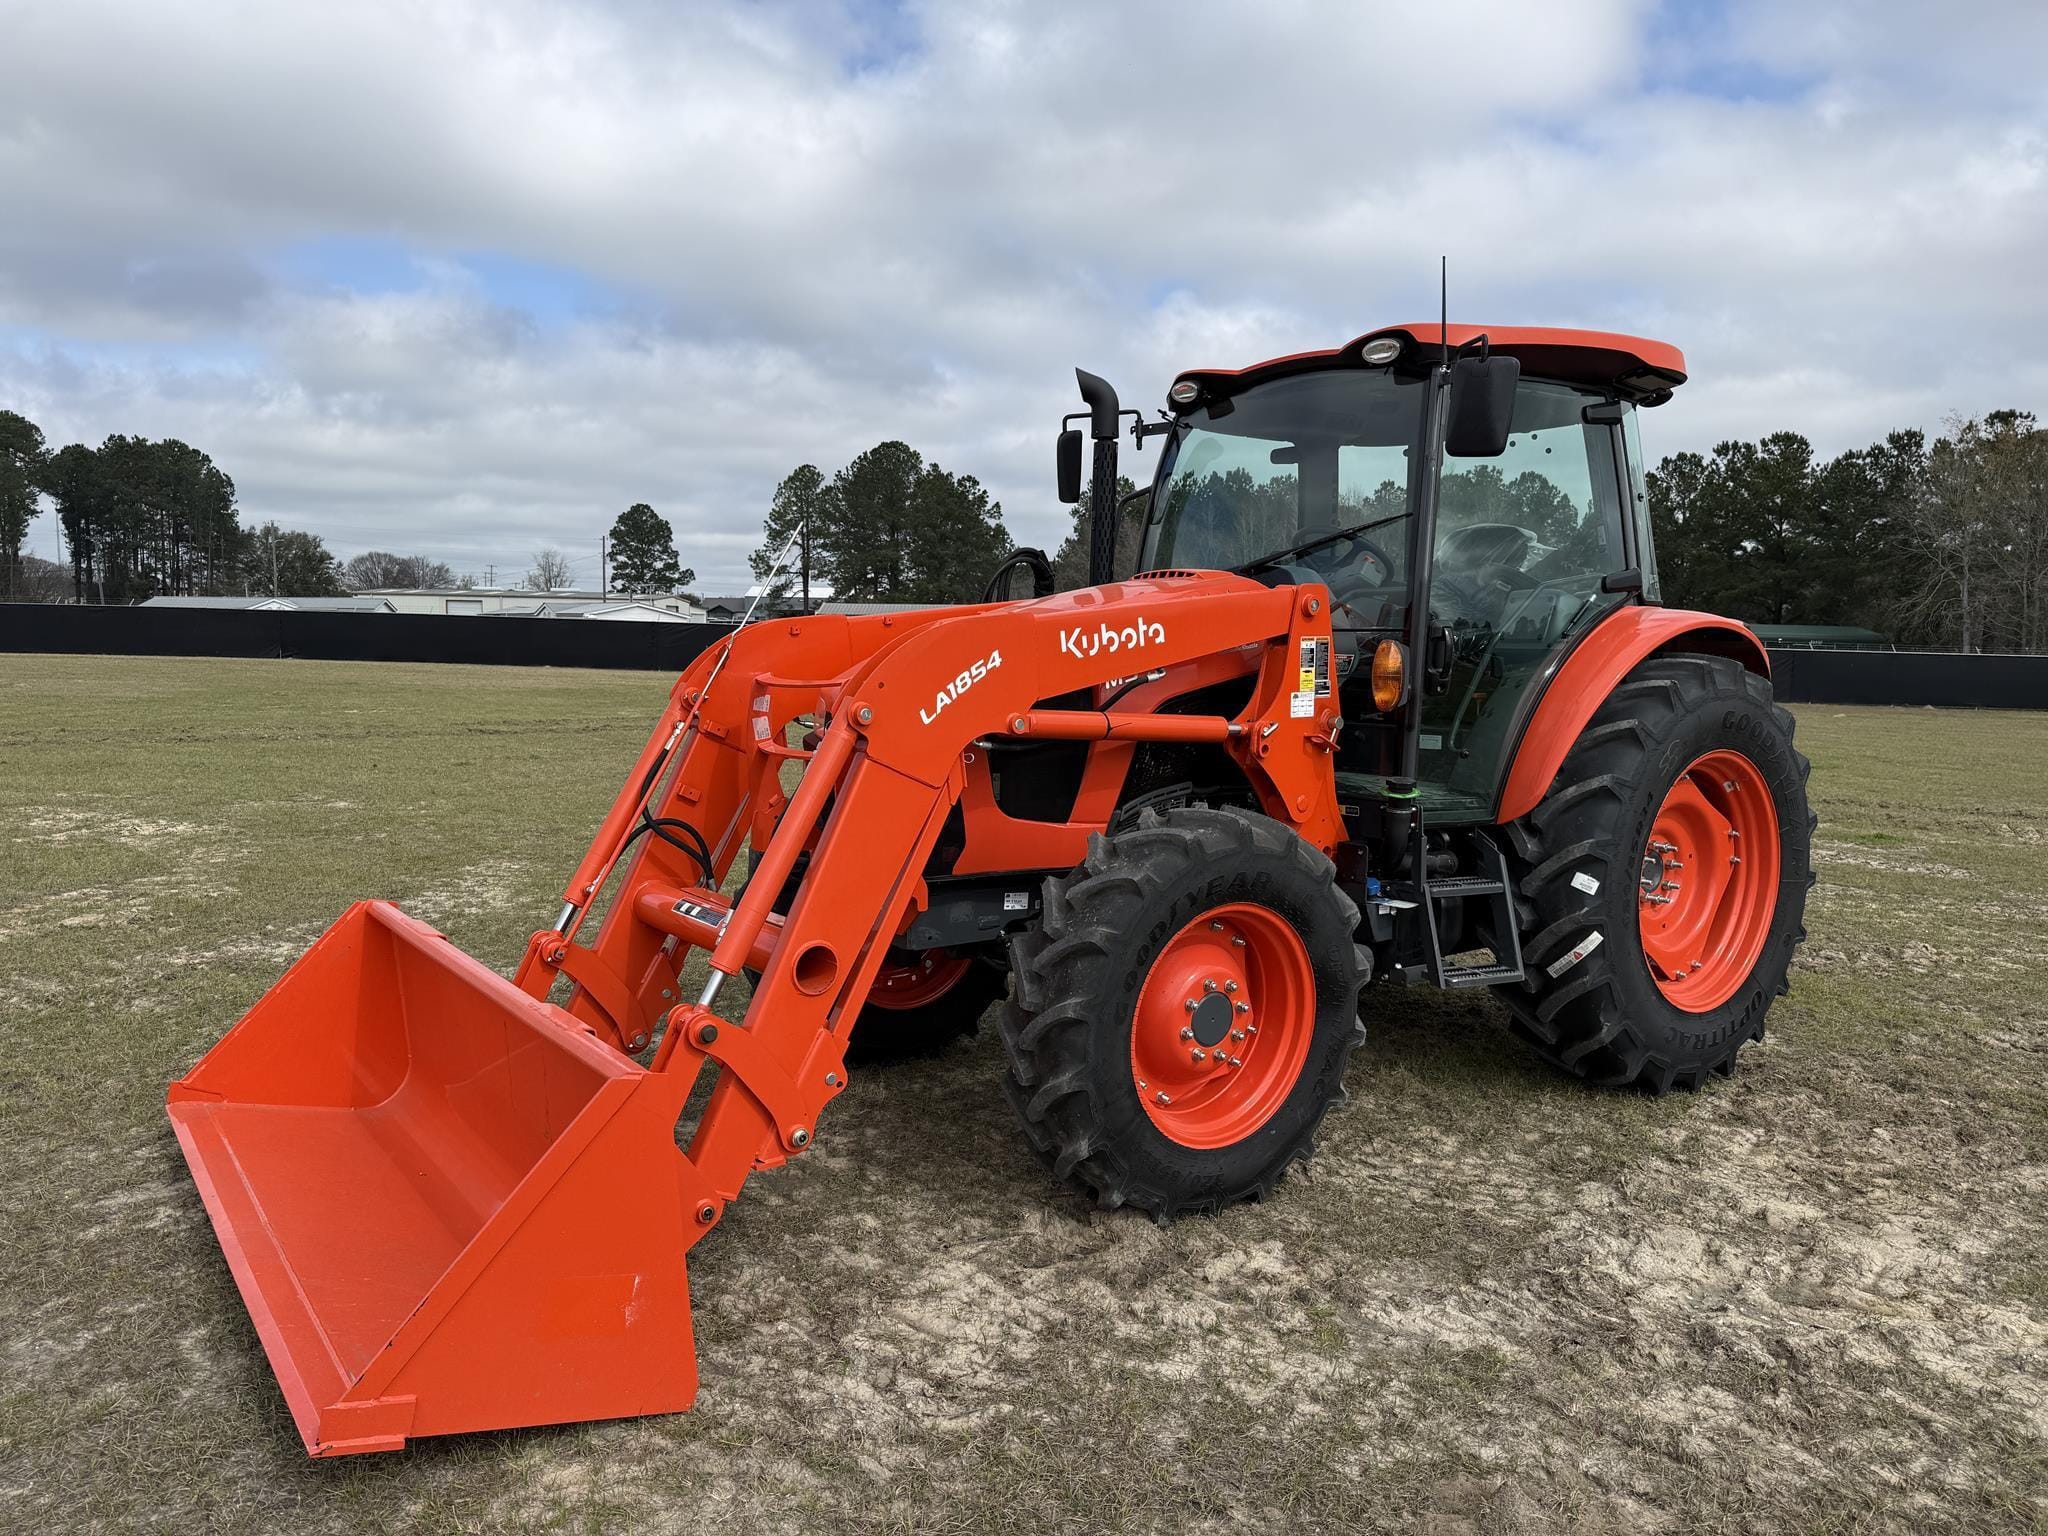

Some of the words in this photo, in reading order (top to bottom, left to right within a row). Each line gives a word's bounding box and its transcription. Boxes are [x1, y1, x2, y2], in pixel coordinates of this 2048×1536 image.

[1059, 616, 1166, 658] Kubota
[918, 649, 1003, 726] LA1854
[1114, 871, 1273, 1026] GOODYEAR
[1664, 990, 1763, 1050] OPTITRAC
